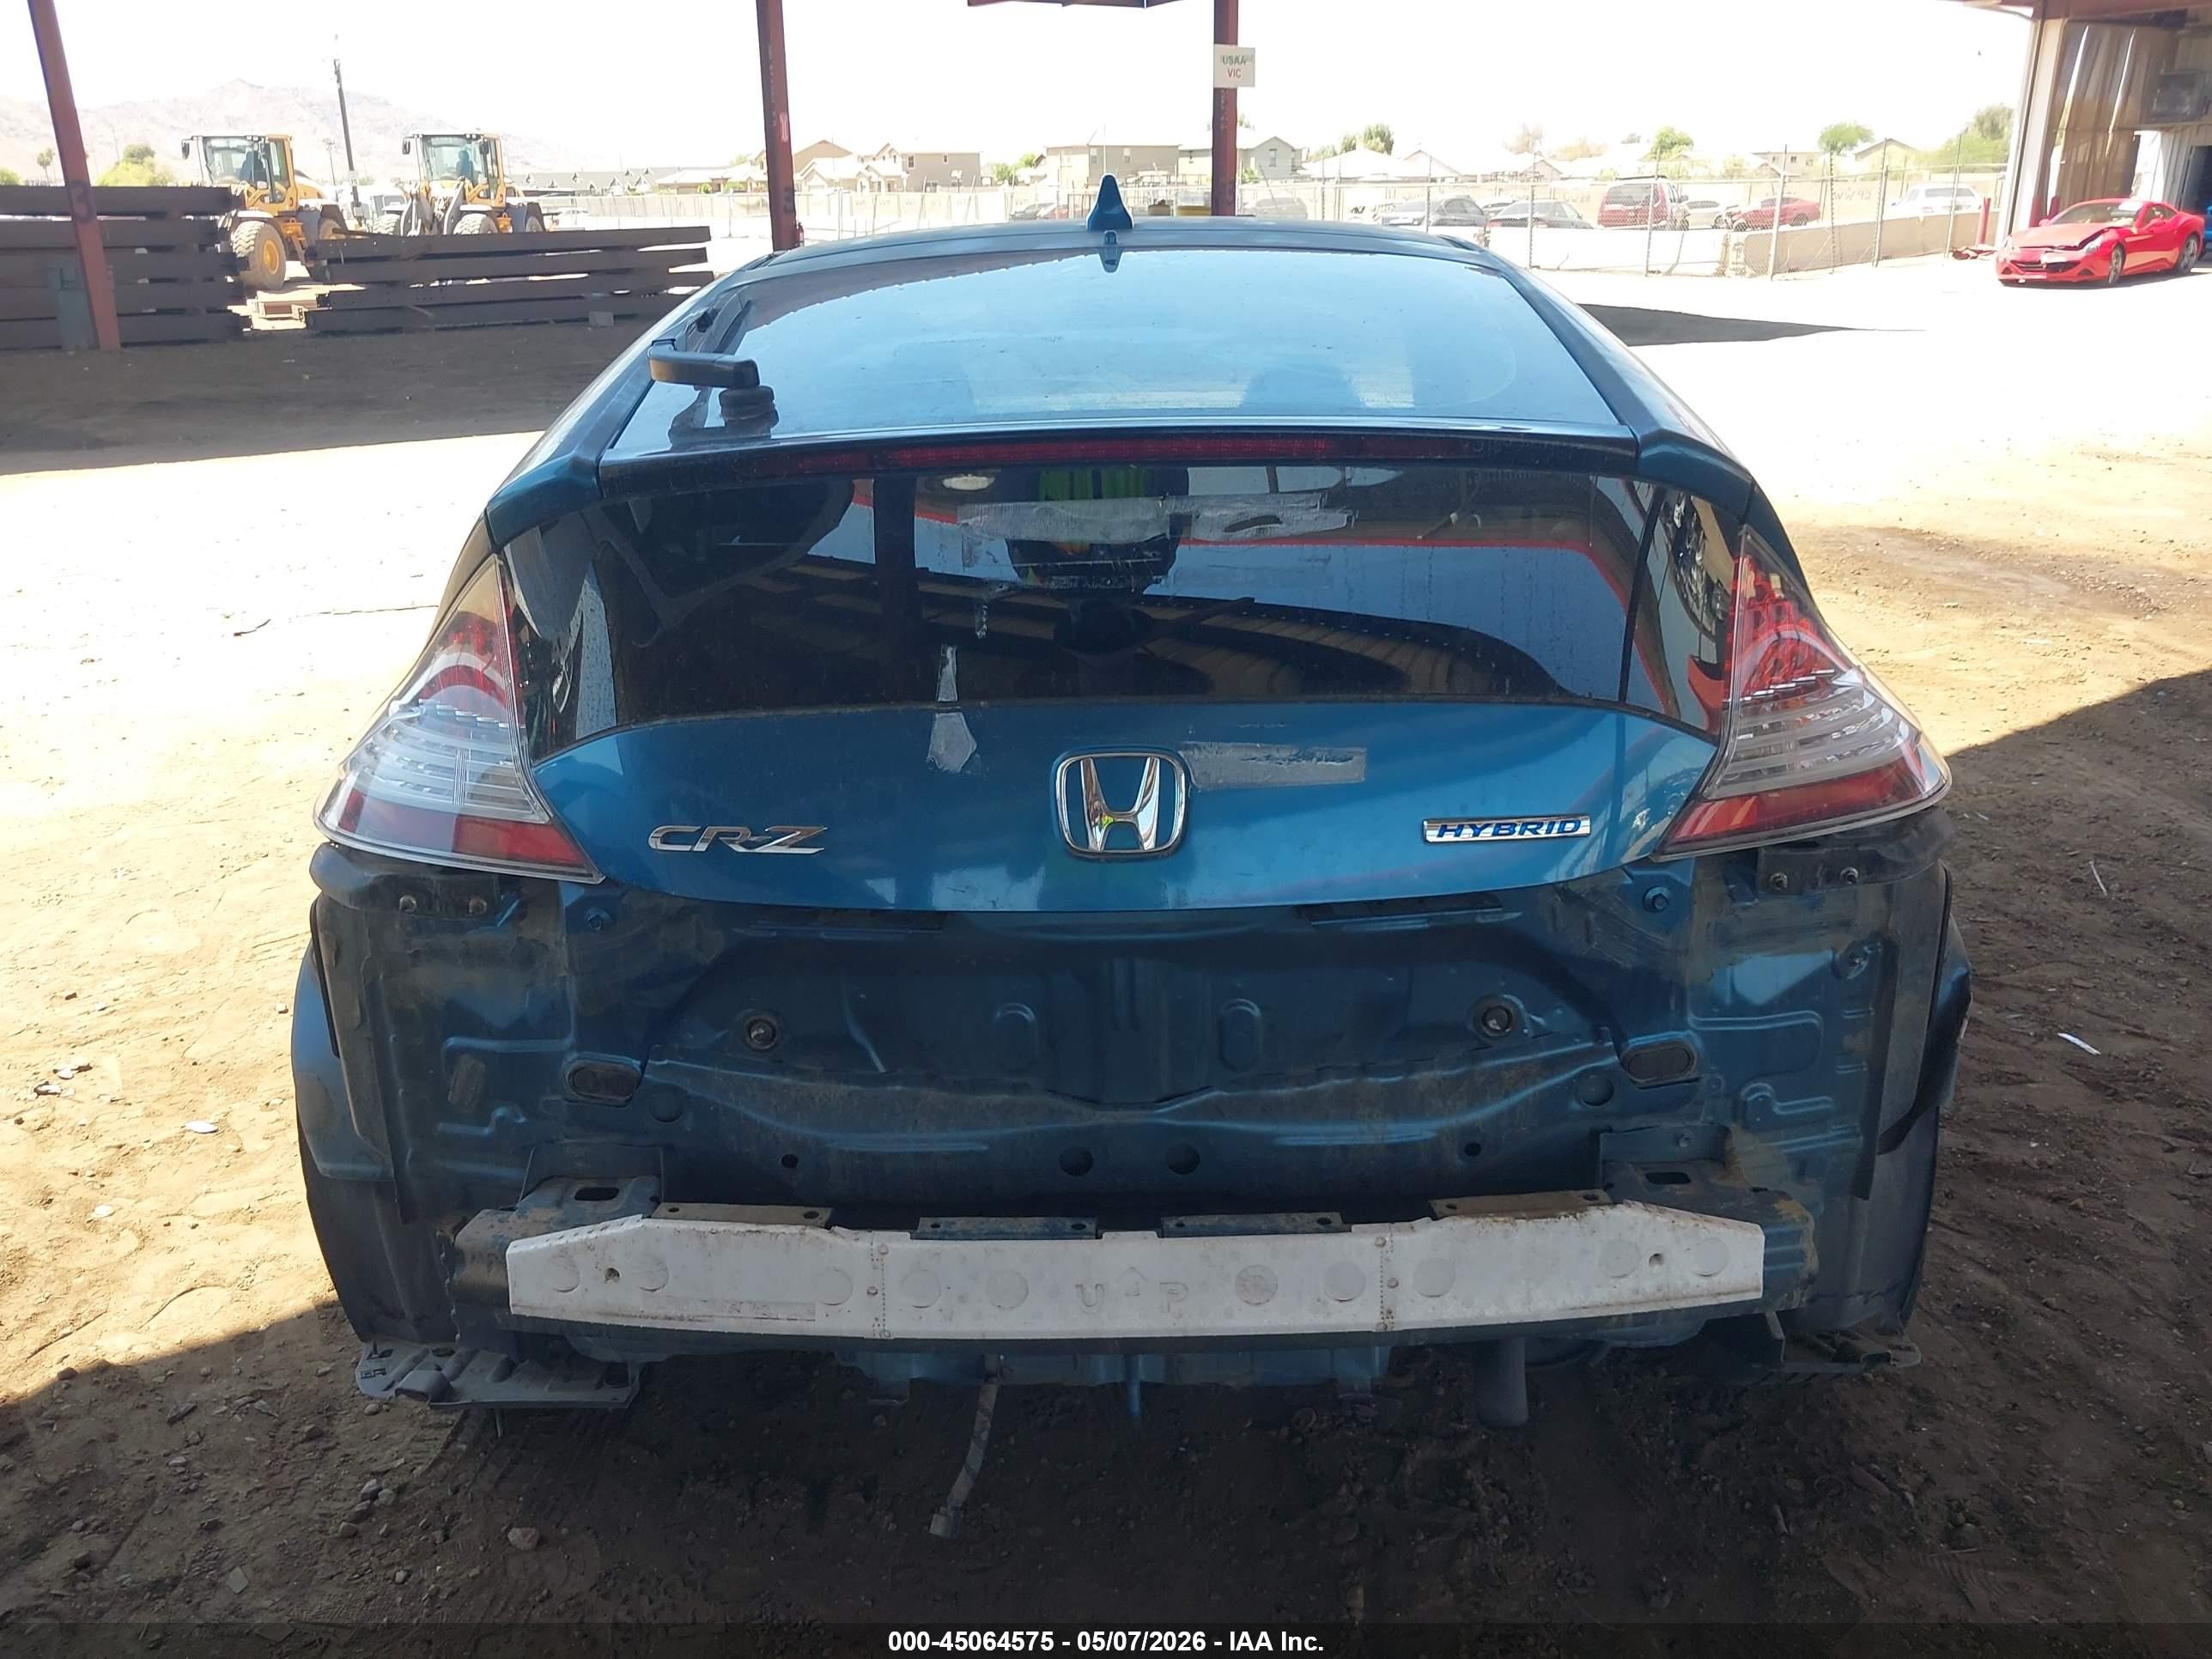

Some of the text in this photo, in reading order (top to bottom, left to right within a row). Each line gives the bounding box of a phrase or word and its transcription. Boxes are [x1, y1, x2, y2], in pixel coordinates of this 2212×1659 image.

[1227, 68, 1242, 78] VIC
[1436, 818, 1582, 838] HYBRID
[647, 825, 830, 854] CR-Z
